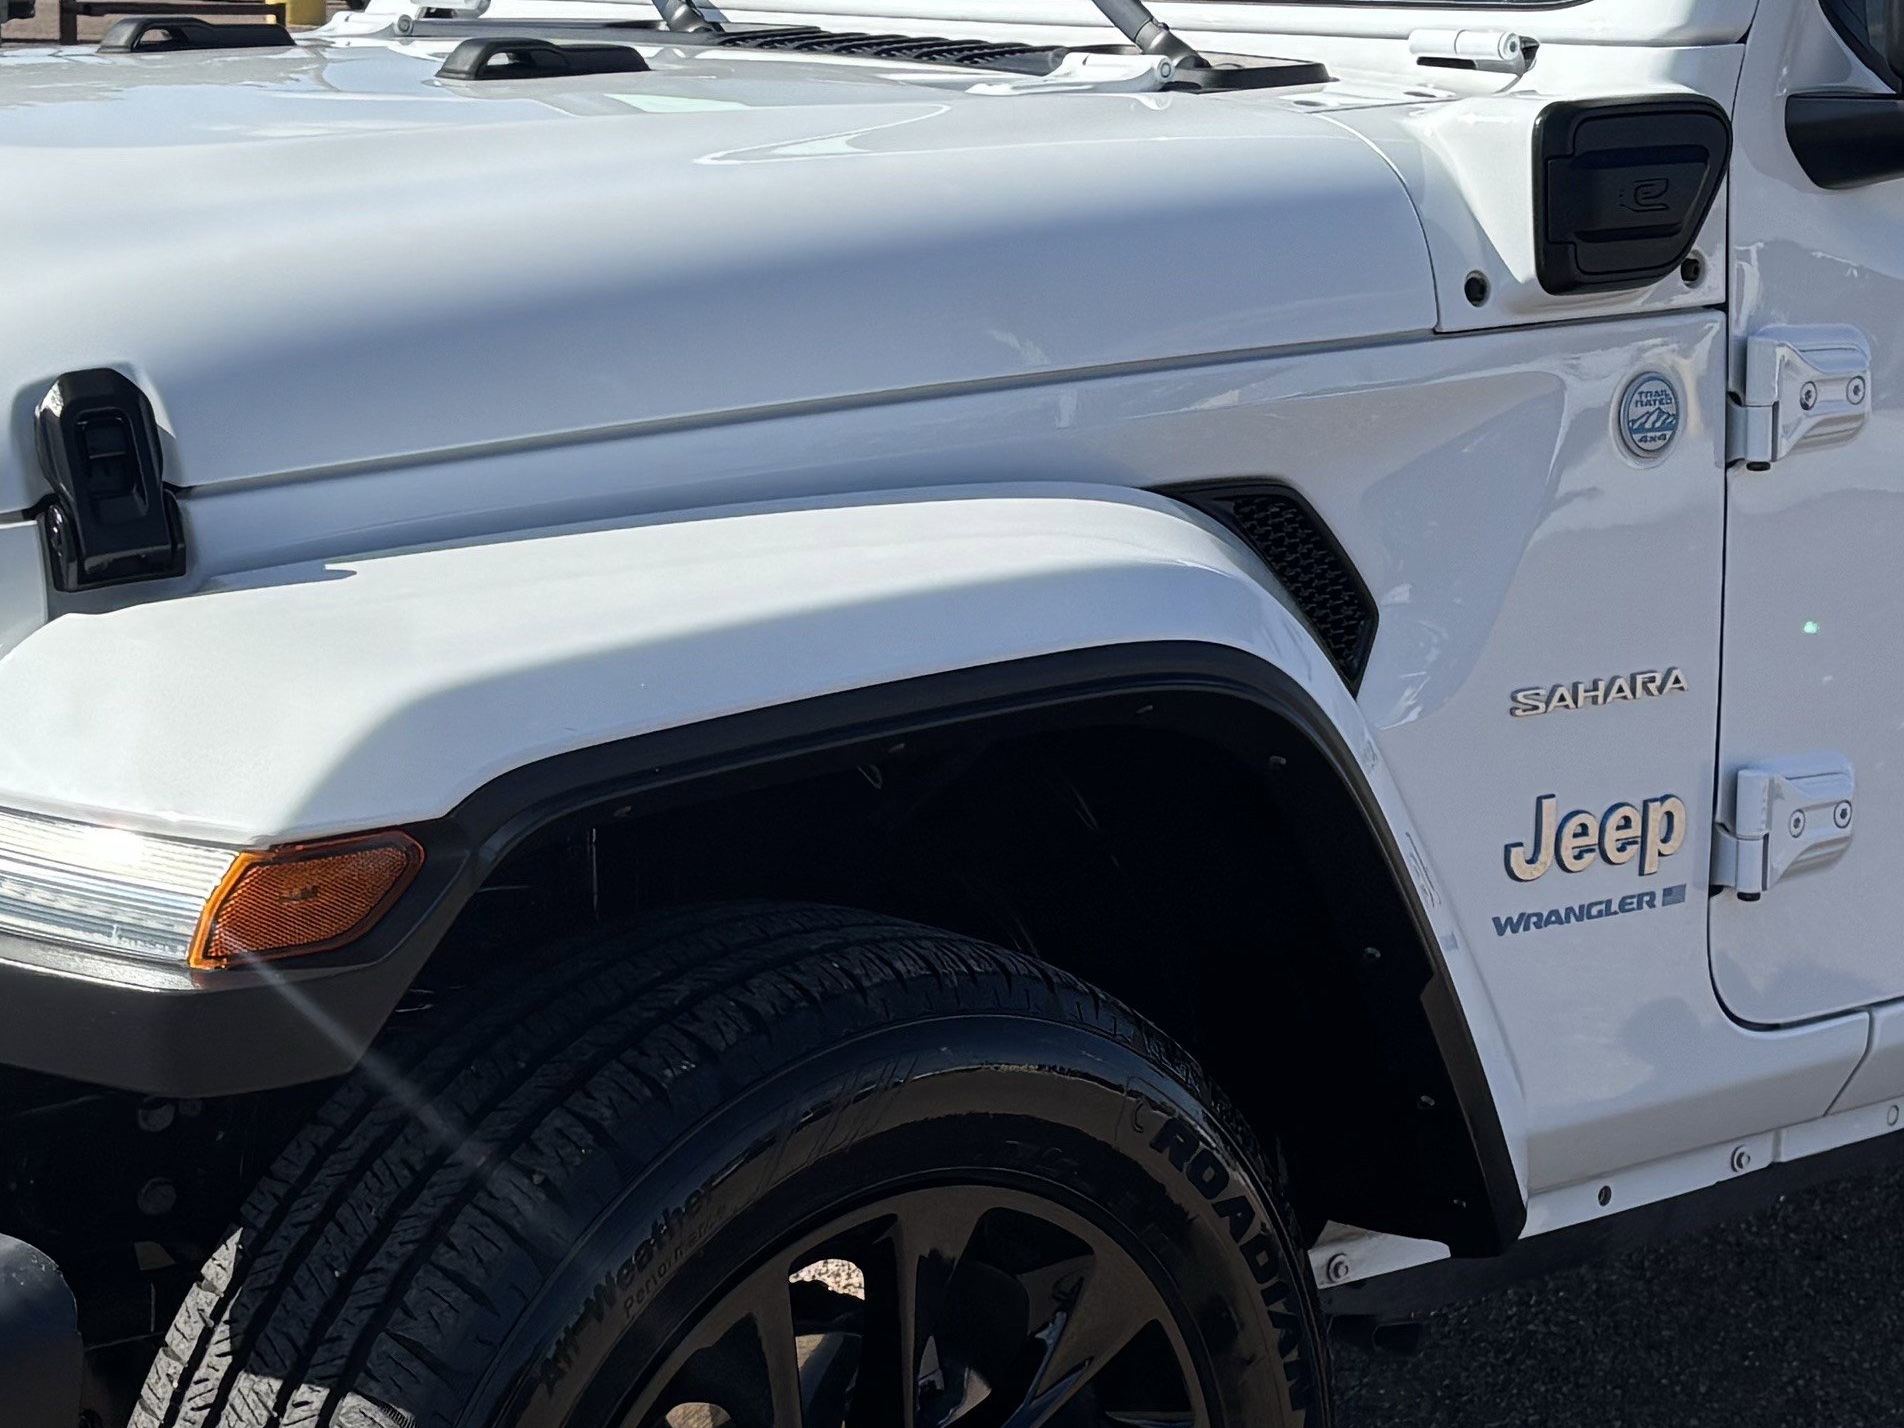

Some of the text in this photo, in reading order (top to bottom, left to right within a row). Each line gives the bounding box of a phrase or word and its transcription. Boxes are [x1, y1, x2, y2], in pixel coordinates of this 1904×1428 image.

[1635, 397, 1673, 408] RATED
[1638, 388, 1670, 400] TRAIL
[1509, 666, 1689, 717] SAHARA
[1504, 793, 1687, 883] Jeep
[1491, 889, 1657, 937] WRANGLER
